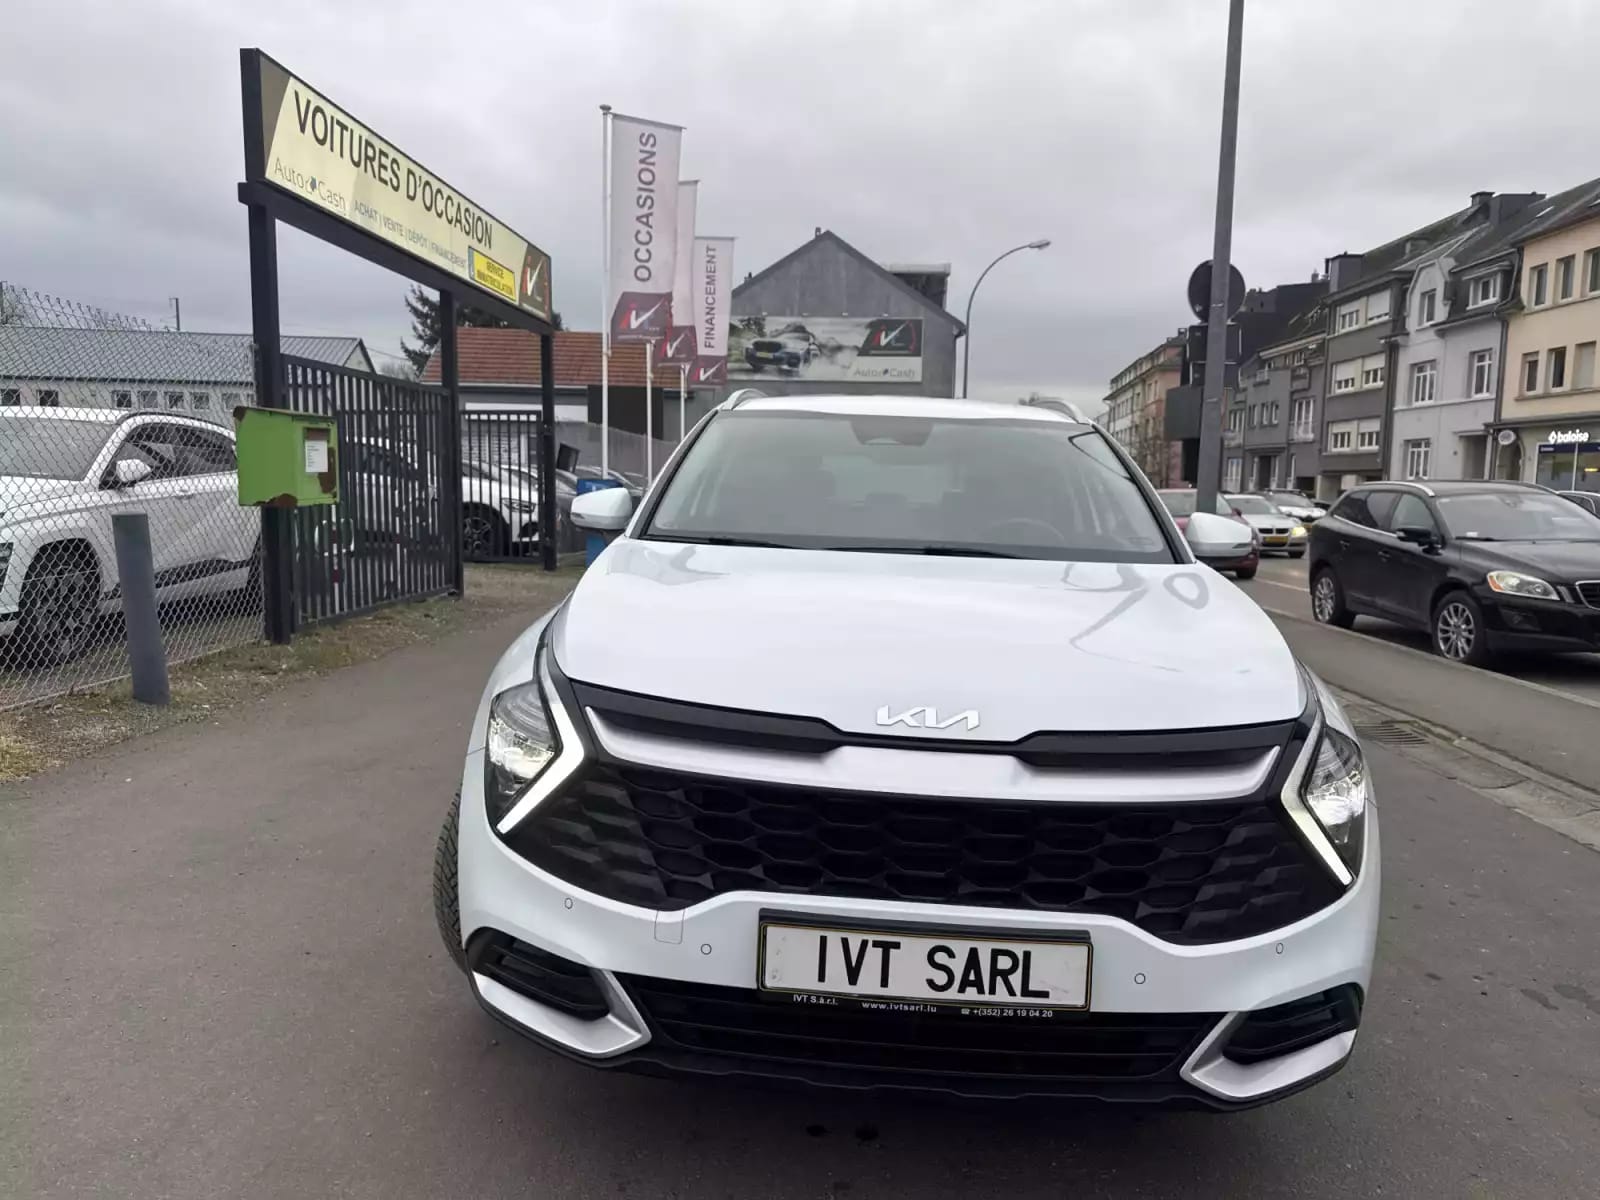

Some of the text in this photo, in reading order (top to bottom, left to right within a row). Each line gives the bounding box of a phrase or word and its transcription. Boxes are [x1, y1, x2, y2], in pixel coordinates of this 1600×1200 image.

[274, 157, 347, 212] Auto Cash
[294, 89, 492, 249] VOITURES D'OCCASION
[354, 199, 378, 220] ACHAT
[383, 216, 404, 237] VENTE
[634, 132, 657, 282] OCCASIONS
[703, 245, 717, 349] FINANCEMENT
[1557, 428, 1590, 443] baloise
[876, 704, 980, 732] KIA
[925, 944, 1050, 999] SARL
[793, 994, 809, 1003] IVT
[861, 1001, 937, 1013] www.ivtsarl.lu
[1003, 1008, 1014, 1017] 26
[1017, 1009, 1027, 1017] 19
[1029, 1009, 1040, 1018] 04
[1042, 1010, 1053, 1018] 20
